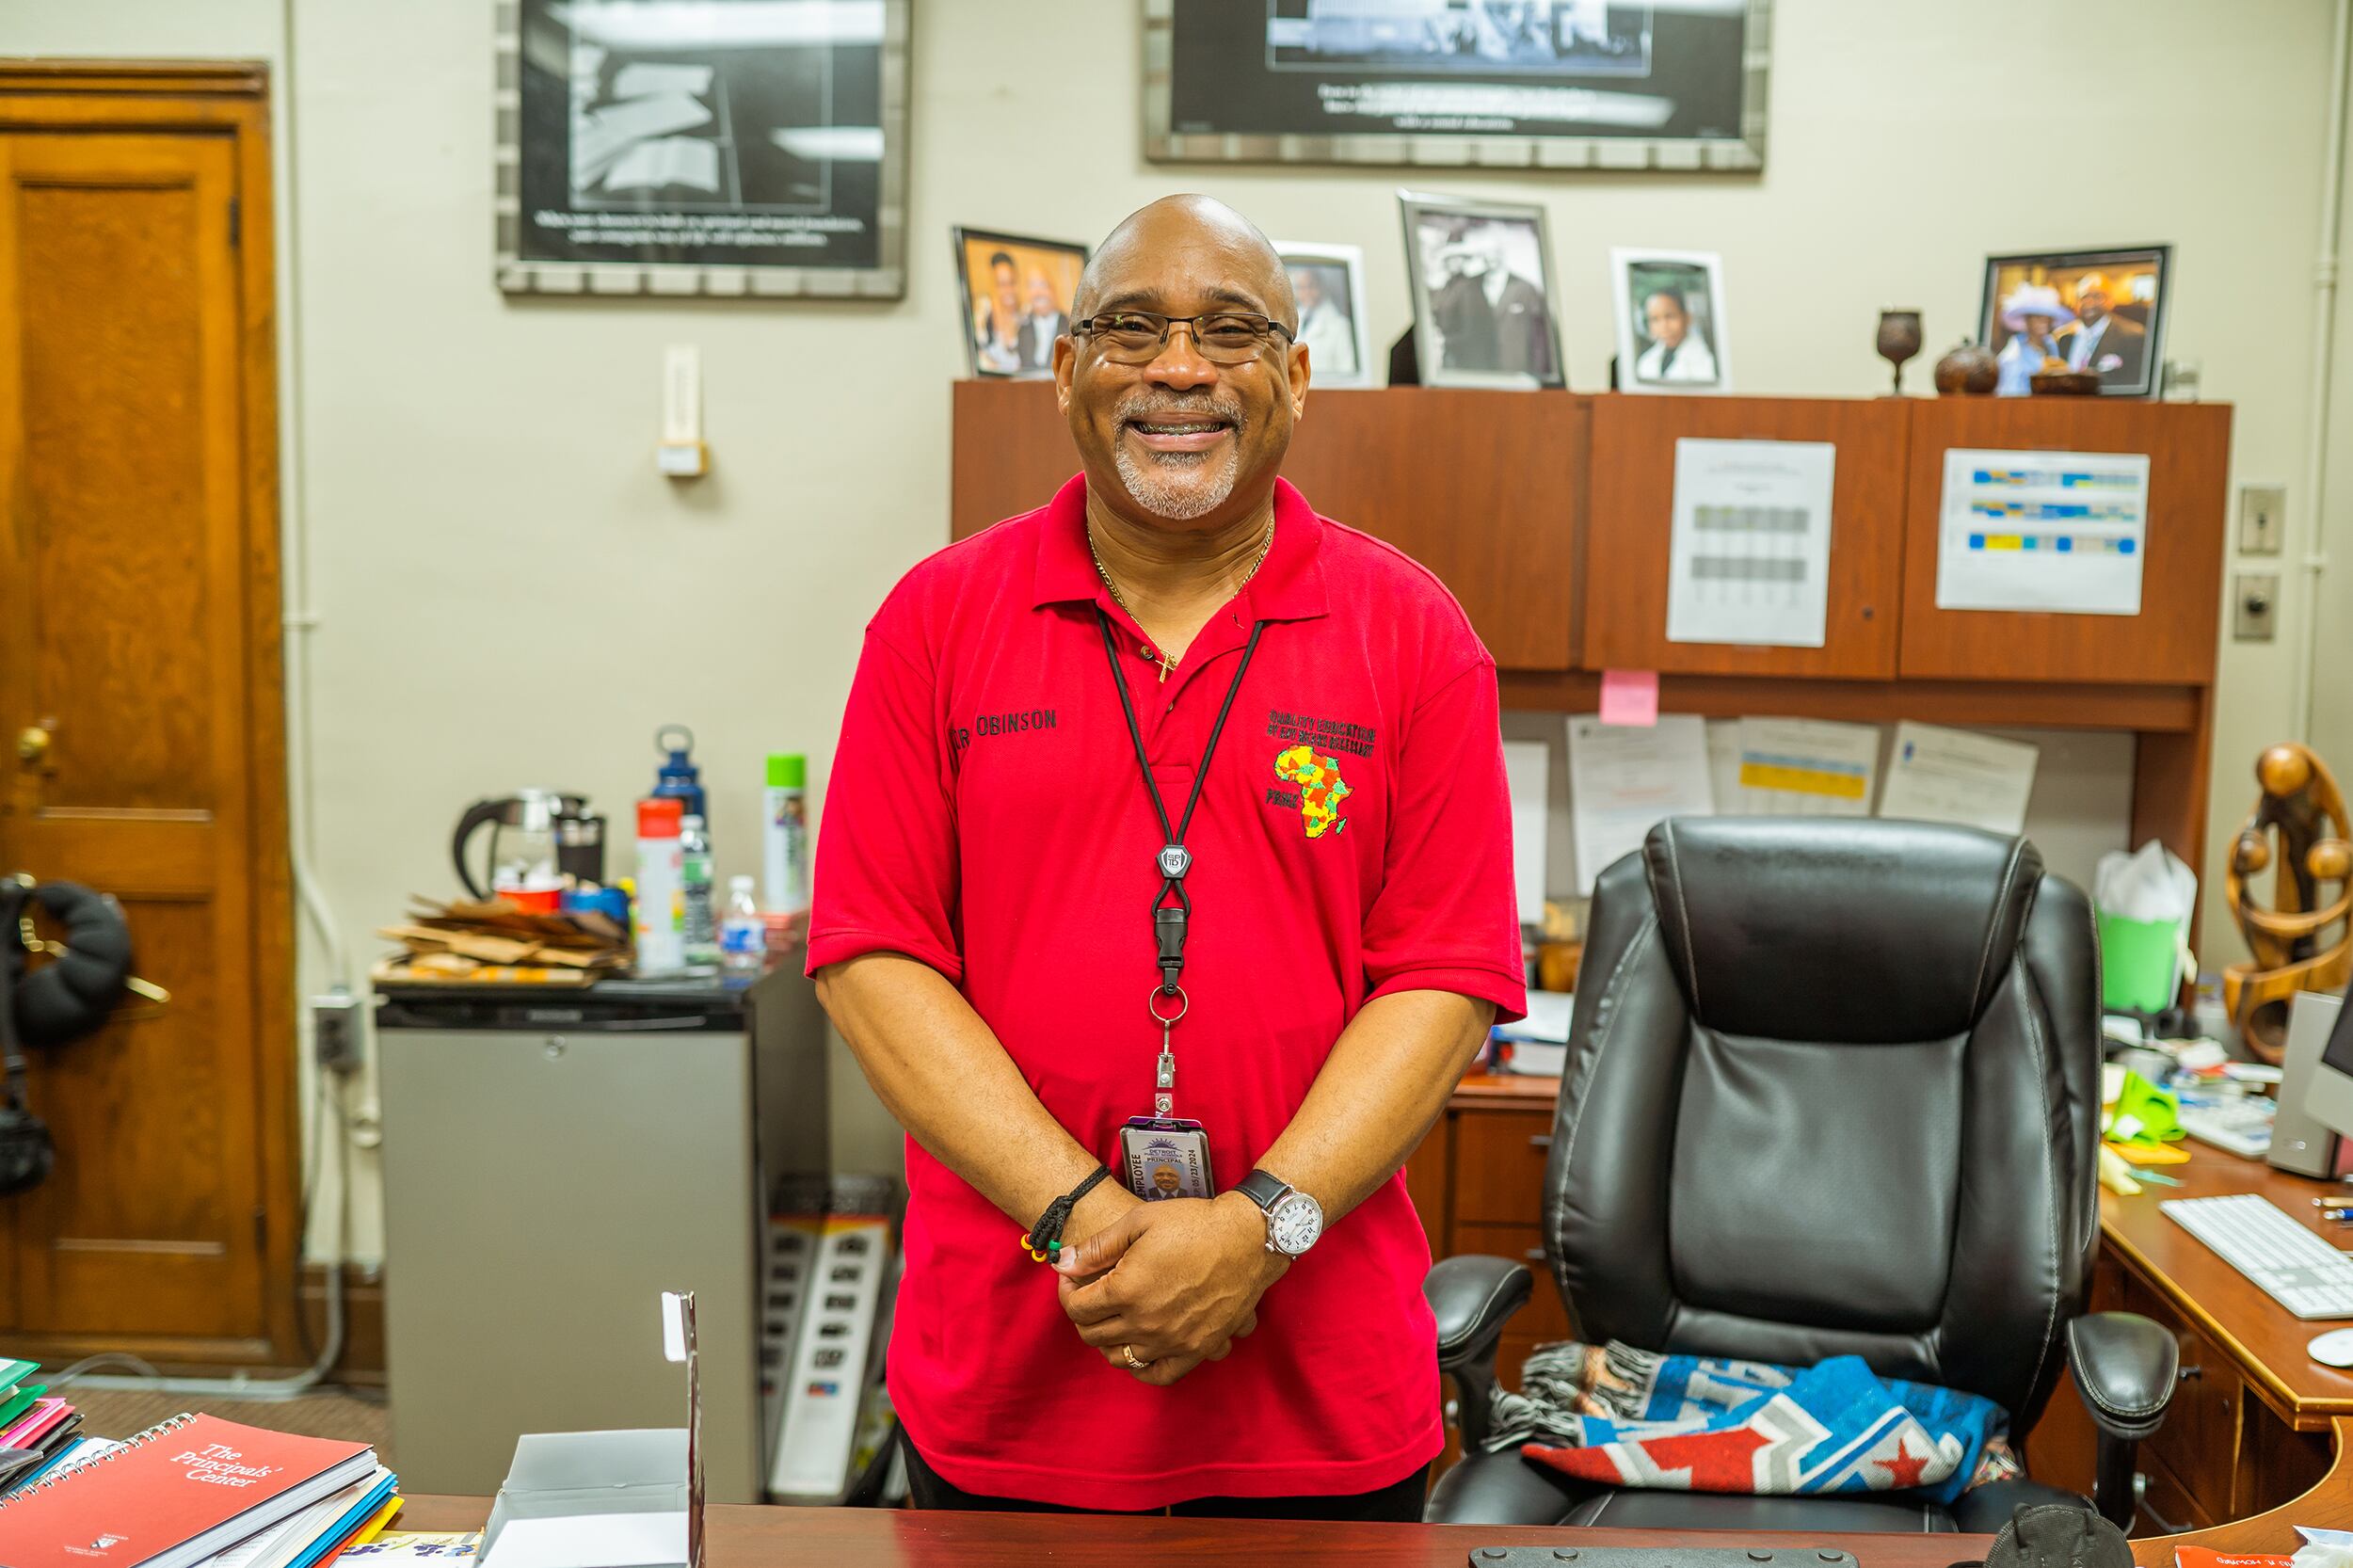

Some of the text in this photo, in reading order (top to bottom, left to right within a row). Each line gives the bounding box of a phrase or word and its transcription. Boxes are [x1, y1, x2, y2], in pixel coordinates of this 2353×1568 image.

[1269, 710, 1375, 743] QUALITY EDUCATION
[200, 1443, 243, 1461] The
[185, 1468, 258, 1488] Center
